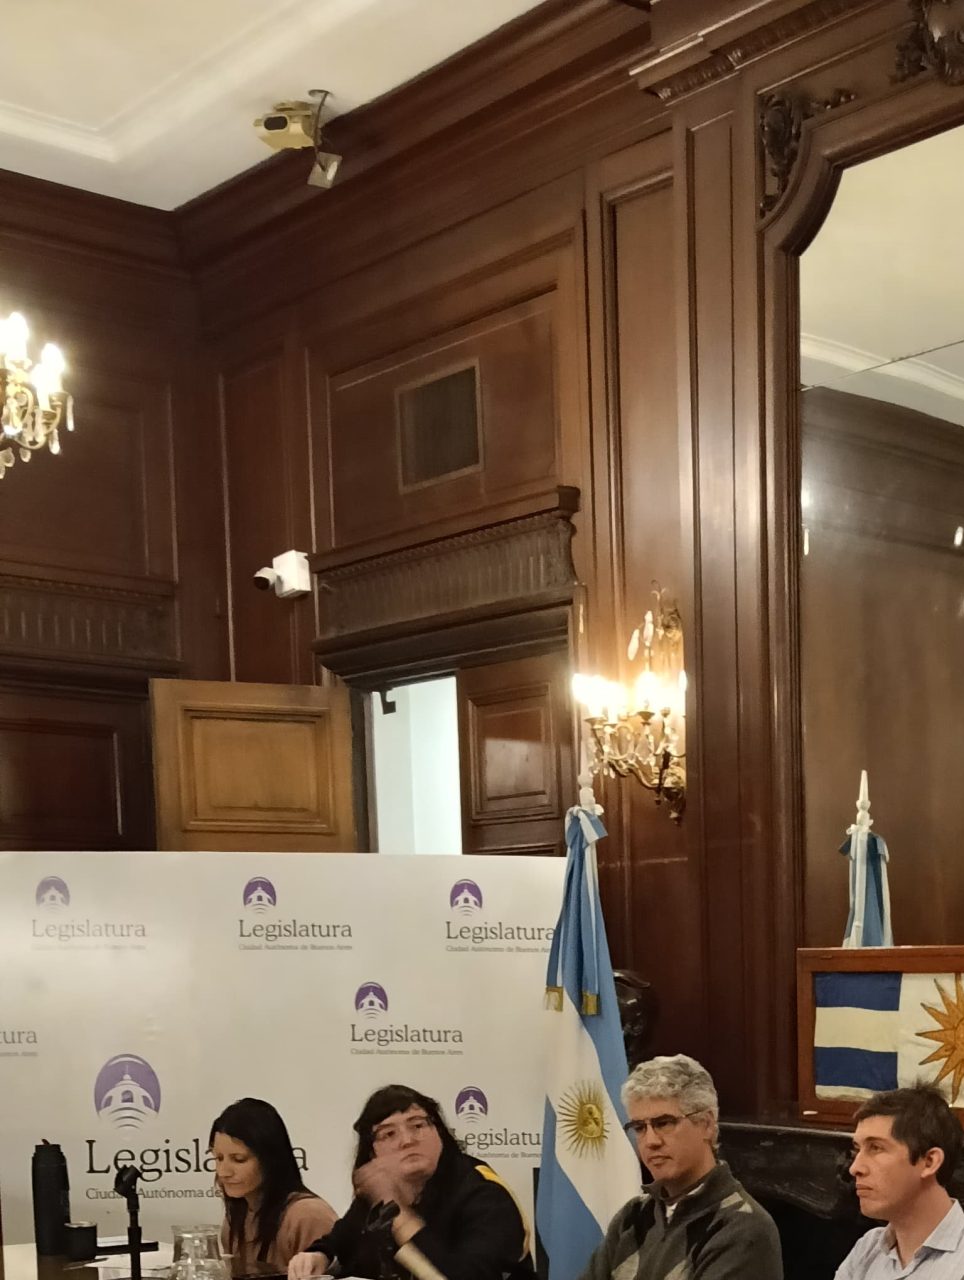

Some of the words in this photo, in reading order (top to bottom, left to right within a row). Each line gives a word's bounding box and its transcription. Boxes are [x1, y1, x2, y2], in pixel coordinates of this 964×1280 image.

[32, 918, 146, 942] Legislatura
[238, 918, 353, 942] Legislatura
[350, 1023, 464, 1047] Legislatura
[137, 1186, 204, 1199] Autónoma
[205, 1186, 222, 1199] de
